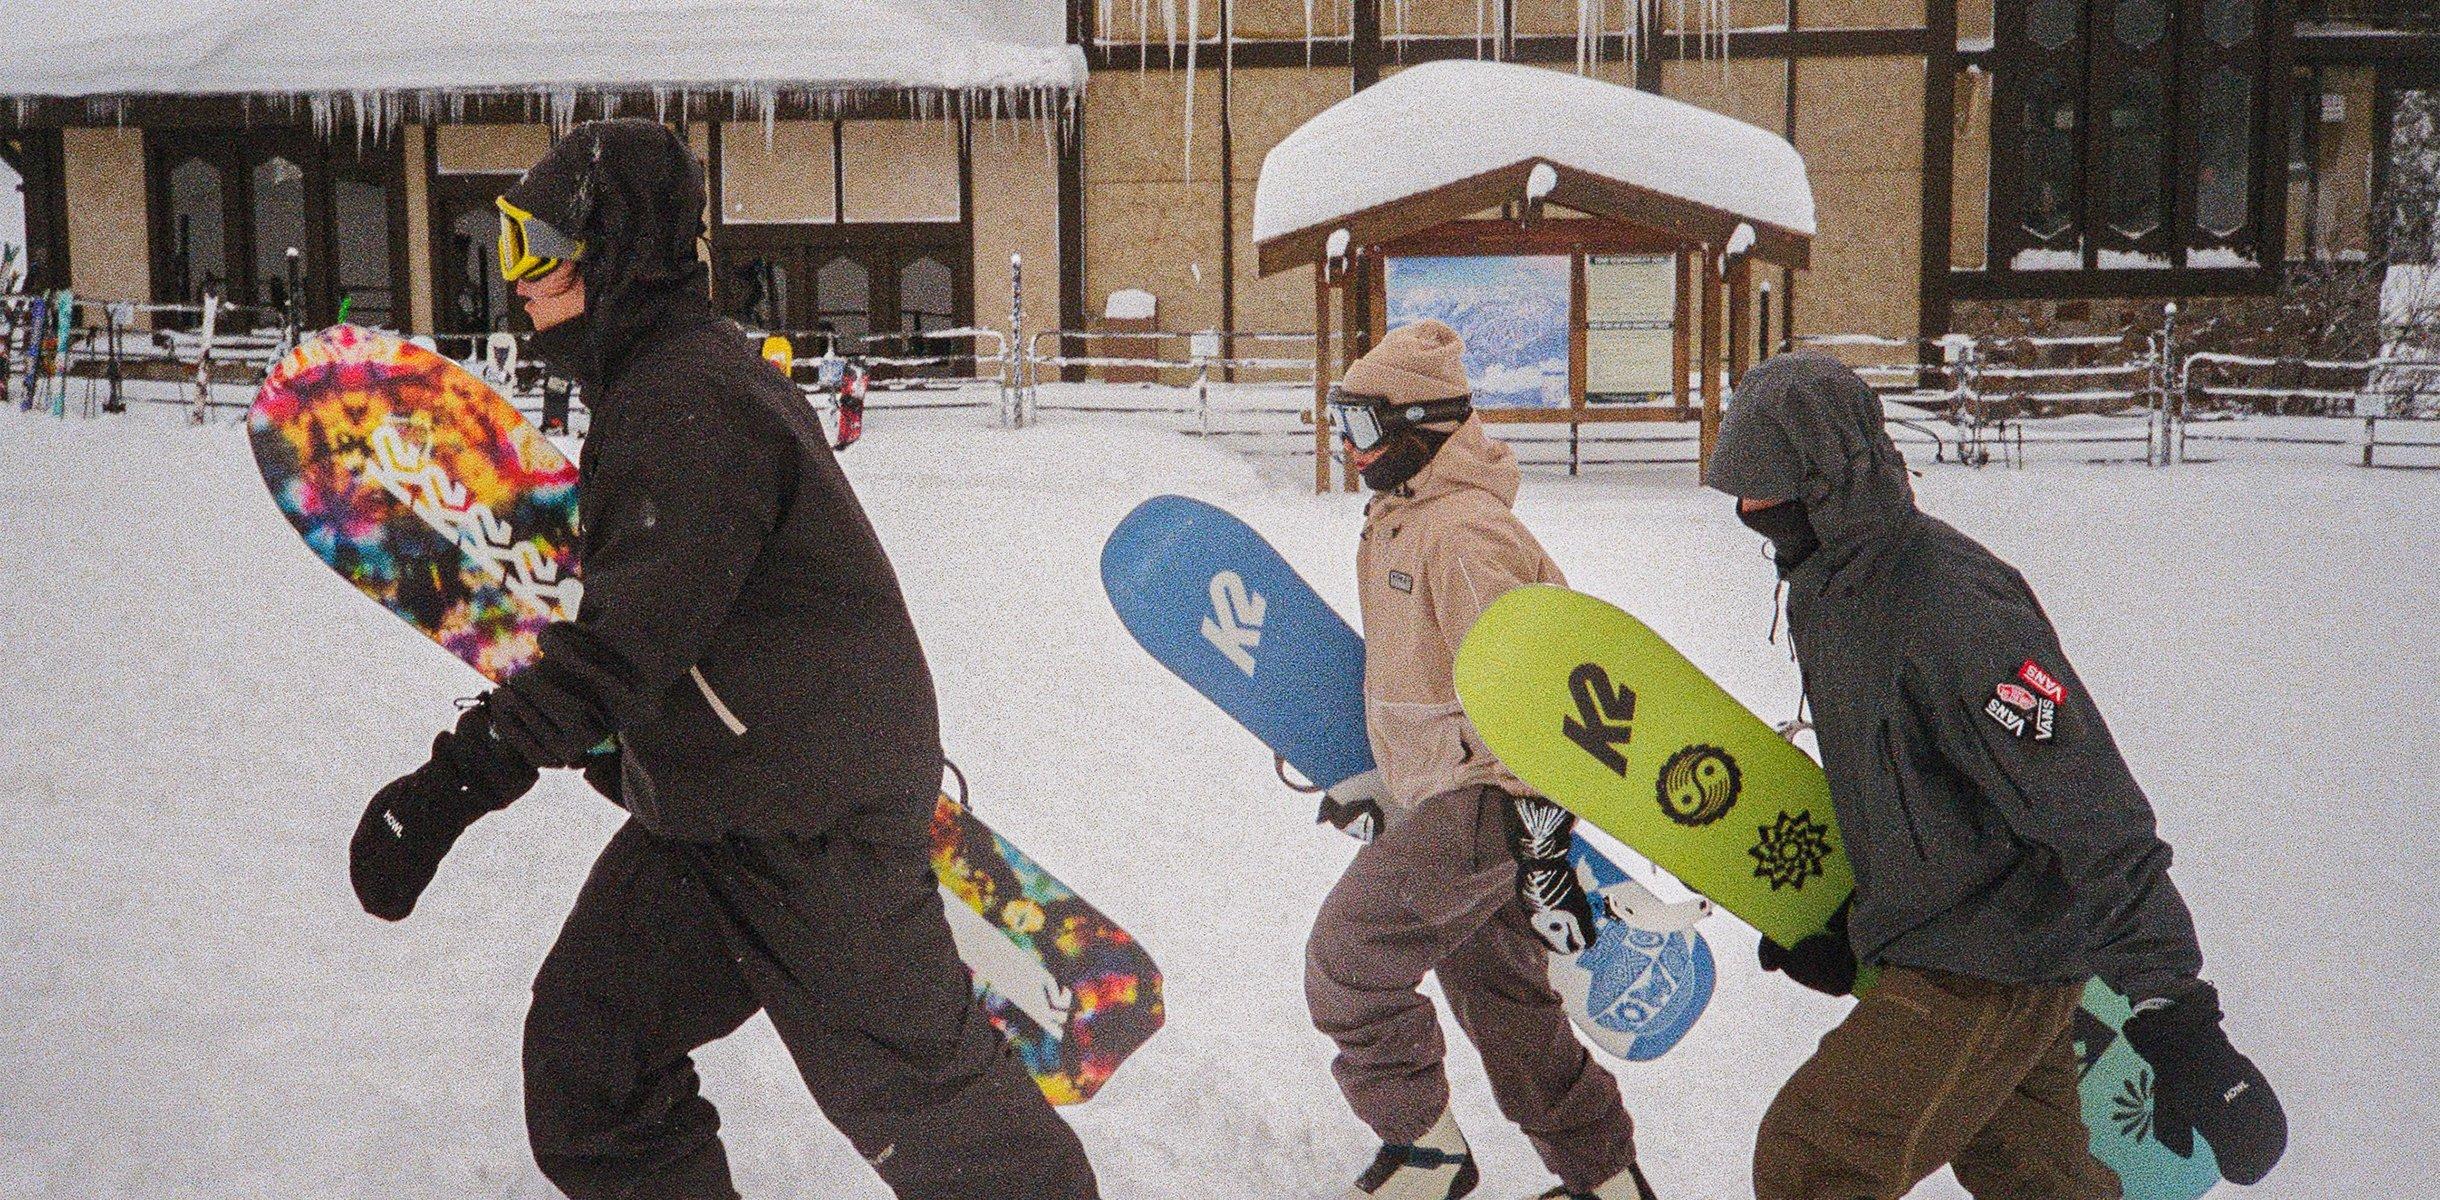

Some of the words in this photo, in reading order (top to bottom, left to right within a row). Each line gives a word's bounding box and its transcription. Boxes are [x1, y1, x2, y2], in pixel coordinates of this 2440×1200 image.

[365, 425, 421, 507] K2
[412, 465, 467, 546] K2
[459, 503, 513, 584] K2
[506, 541, 558, 618] K2
[1201, 570, 1267, 678] K2
[1562, 662, 1637, 778] K2
[1985, 698, 2026, 737] VANS
[2023, 665, 2061, 702] VANS
[2035, 697, 2055, 740] VANS
